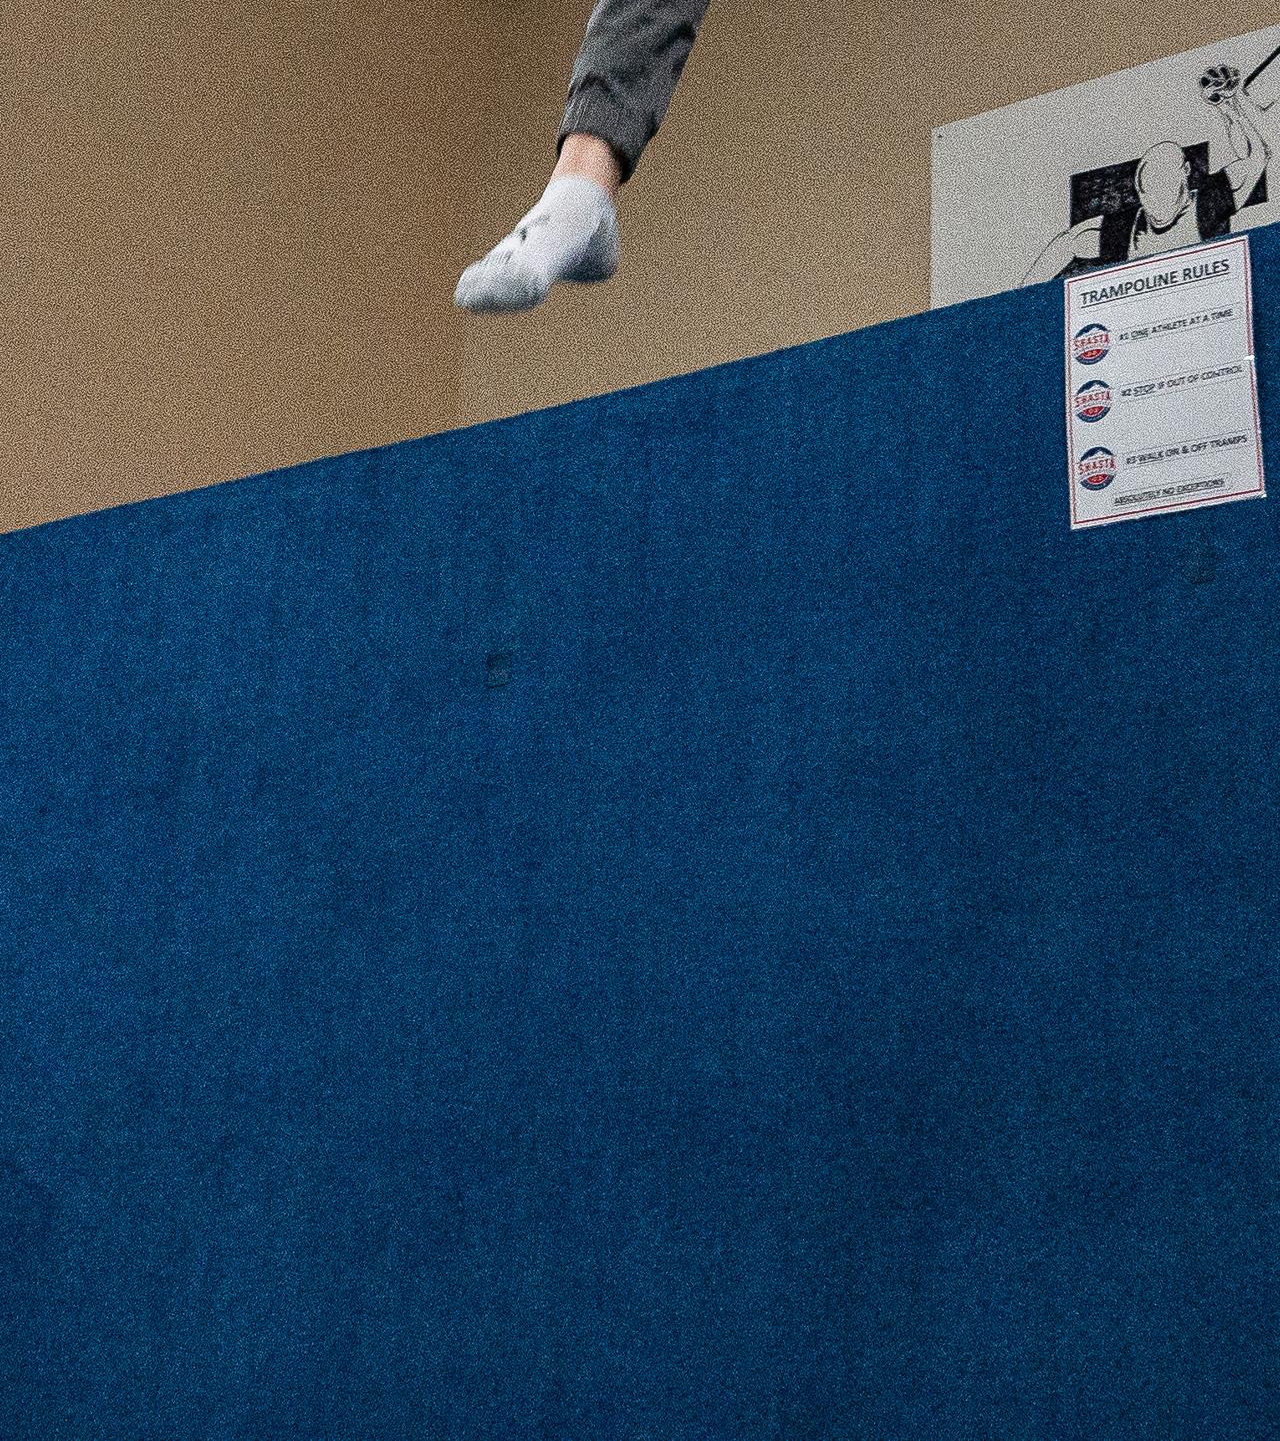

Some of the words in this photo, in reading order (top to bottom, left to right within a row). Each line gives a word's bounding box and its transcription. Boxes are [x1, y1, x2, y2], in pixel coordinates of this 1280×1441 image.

[1081, 270, 1178, 306] TRAMPOLINE
[1182, 258, 1230, 282] RULES
[1200, 364, 1243, 382] CONTROL
[1191, 441, 1208, 454] OFF
[1078, 457, 1117, 475] SHASTA
